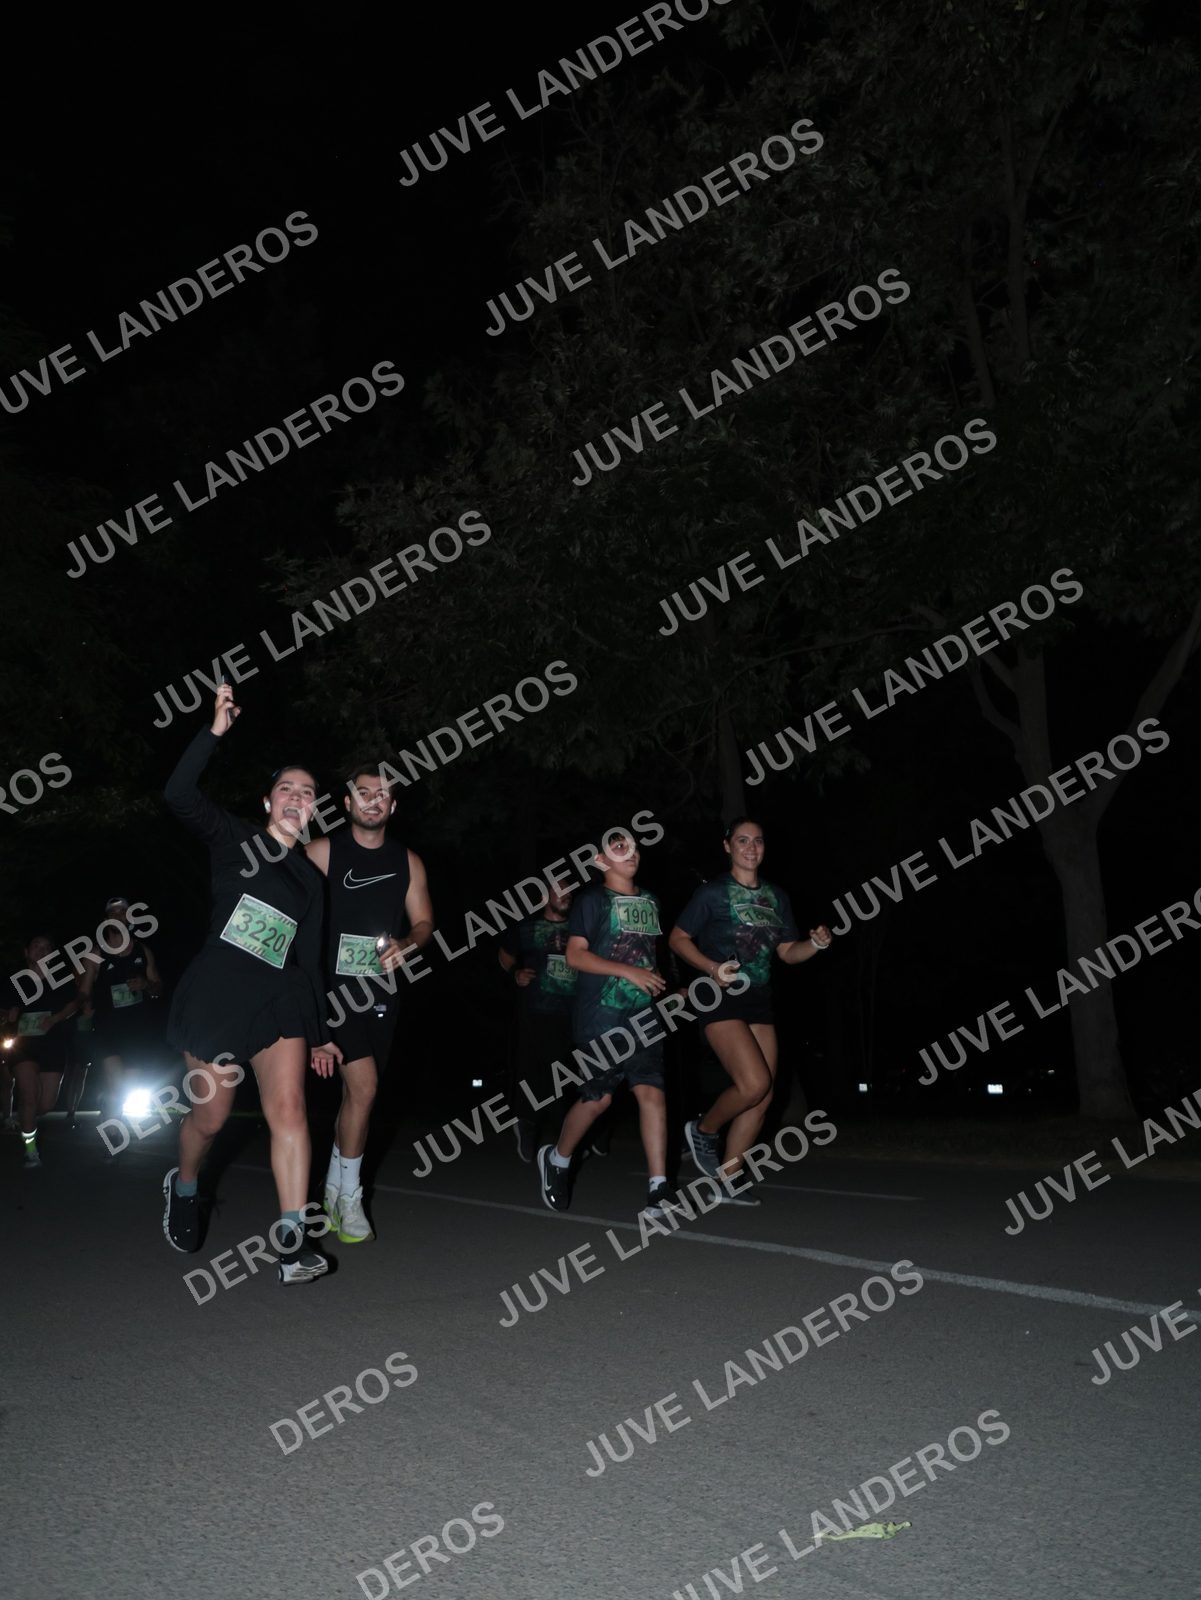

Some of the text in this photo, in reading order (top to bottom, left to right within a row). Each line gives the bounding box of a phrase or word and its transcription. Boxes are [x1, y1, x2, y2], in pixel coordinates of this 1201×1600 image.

[624, 908, 654, 926] 1901
[236, 913, 286, 953] 3220
[345, 948, 378, 967] 322
